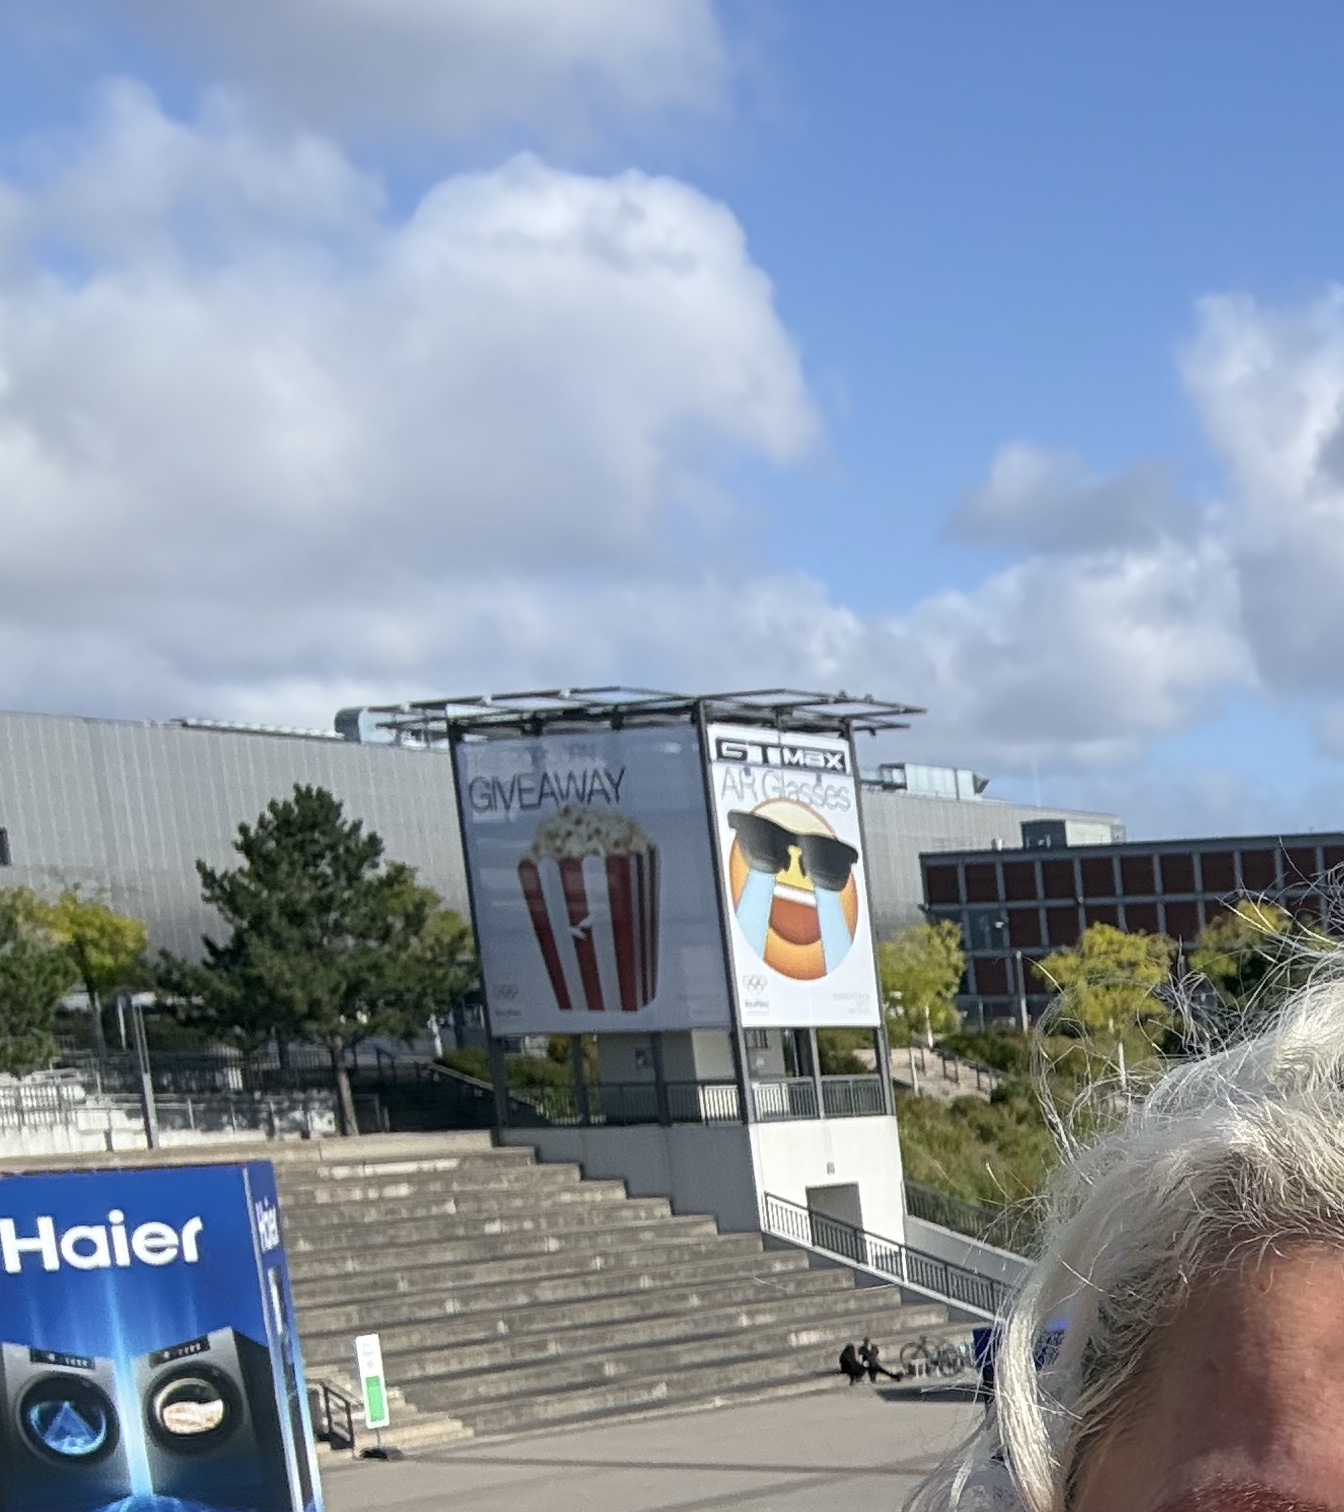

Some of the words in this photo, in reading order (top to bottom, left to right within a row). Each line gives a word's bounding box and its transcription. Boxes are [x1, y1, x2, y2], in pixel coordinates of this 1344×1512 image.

[468, 766, 627, 813] GIVEAWAY
[762, 770, 851, 813] Glasses
[0, 1209, 204, 1274] Haier
